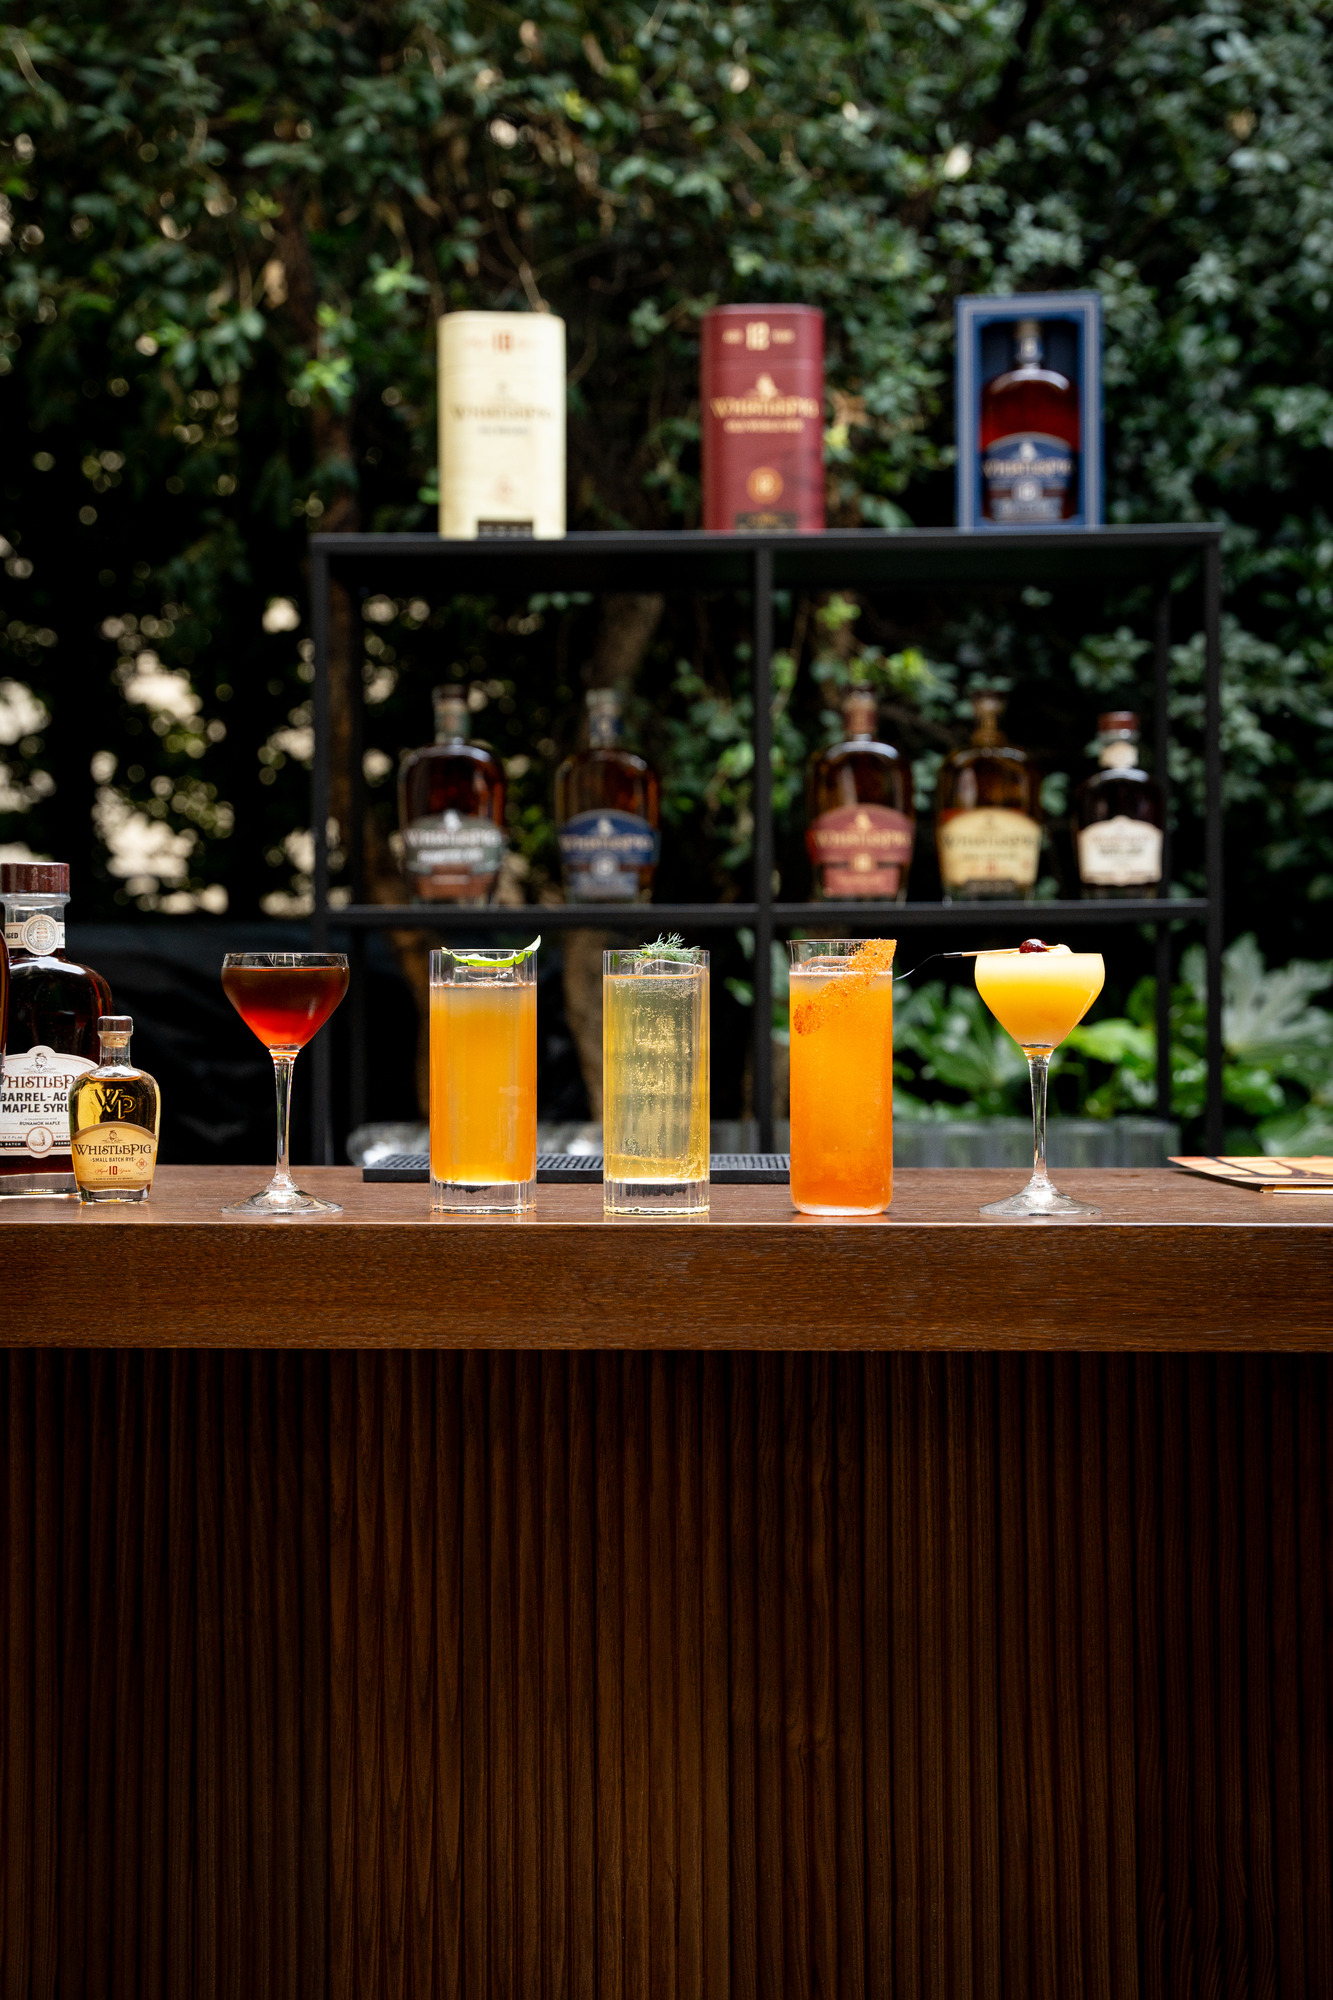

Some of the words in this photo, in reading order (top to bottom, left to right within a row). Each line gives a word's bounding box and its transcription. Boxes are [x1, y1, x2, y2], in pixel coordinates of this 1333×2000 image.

[2, 1103, 41, 1113] MAPLE
[74, 1144, 152, 1155] WHISTLEPIG
[109, 1166, 118, 1175] 10
